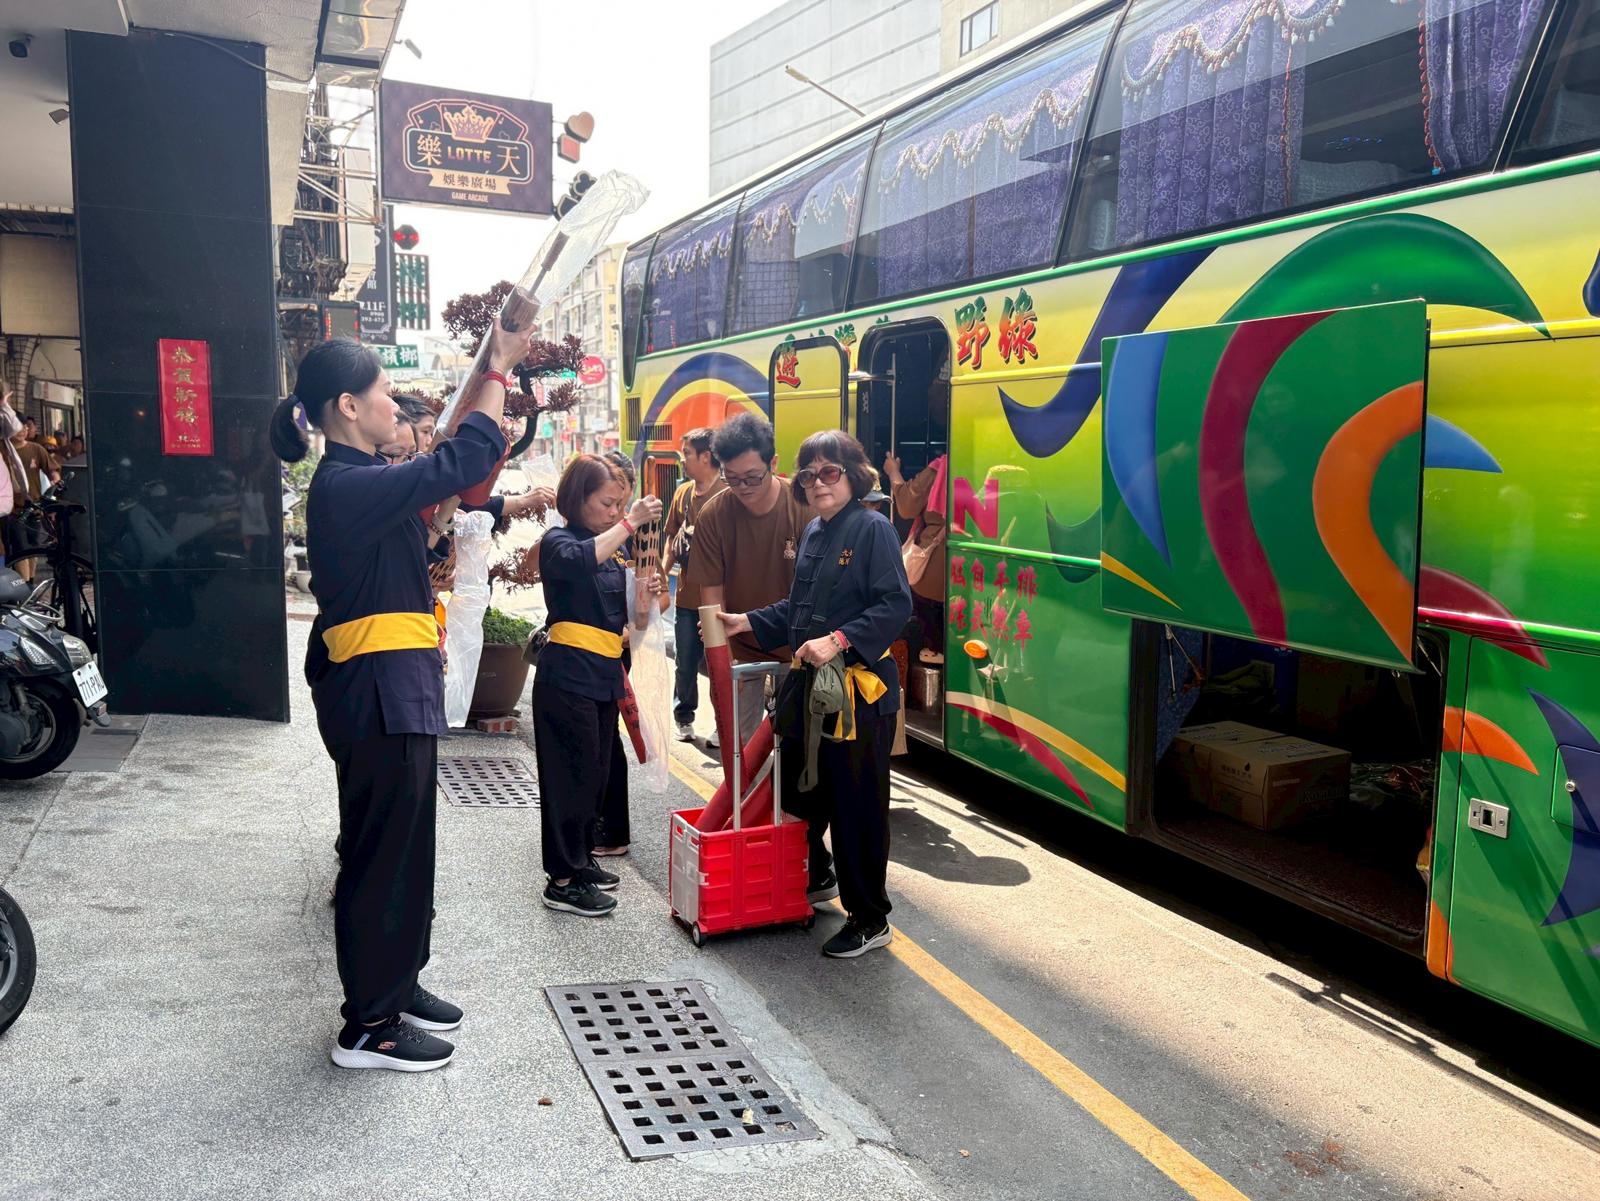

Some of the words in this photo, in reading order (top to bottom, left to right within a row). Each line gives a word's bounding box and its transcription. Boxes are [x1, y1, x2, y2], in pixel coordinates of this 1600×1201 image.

[417, 134, 442, 166] 樂
[447, 145, 492, 165] LOTTE
[496, 144, 521, 175] 天
[451, 191, 467, 201] GAME
[467, 193, 489, 203] ARCADE
